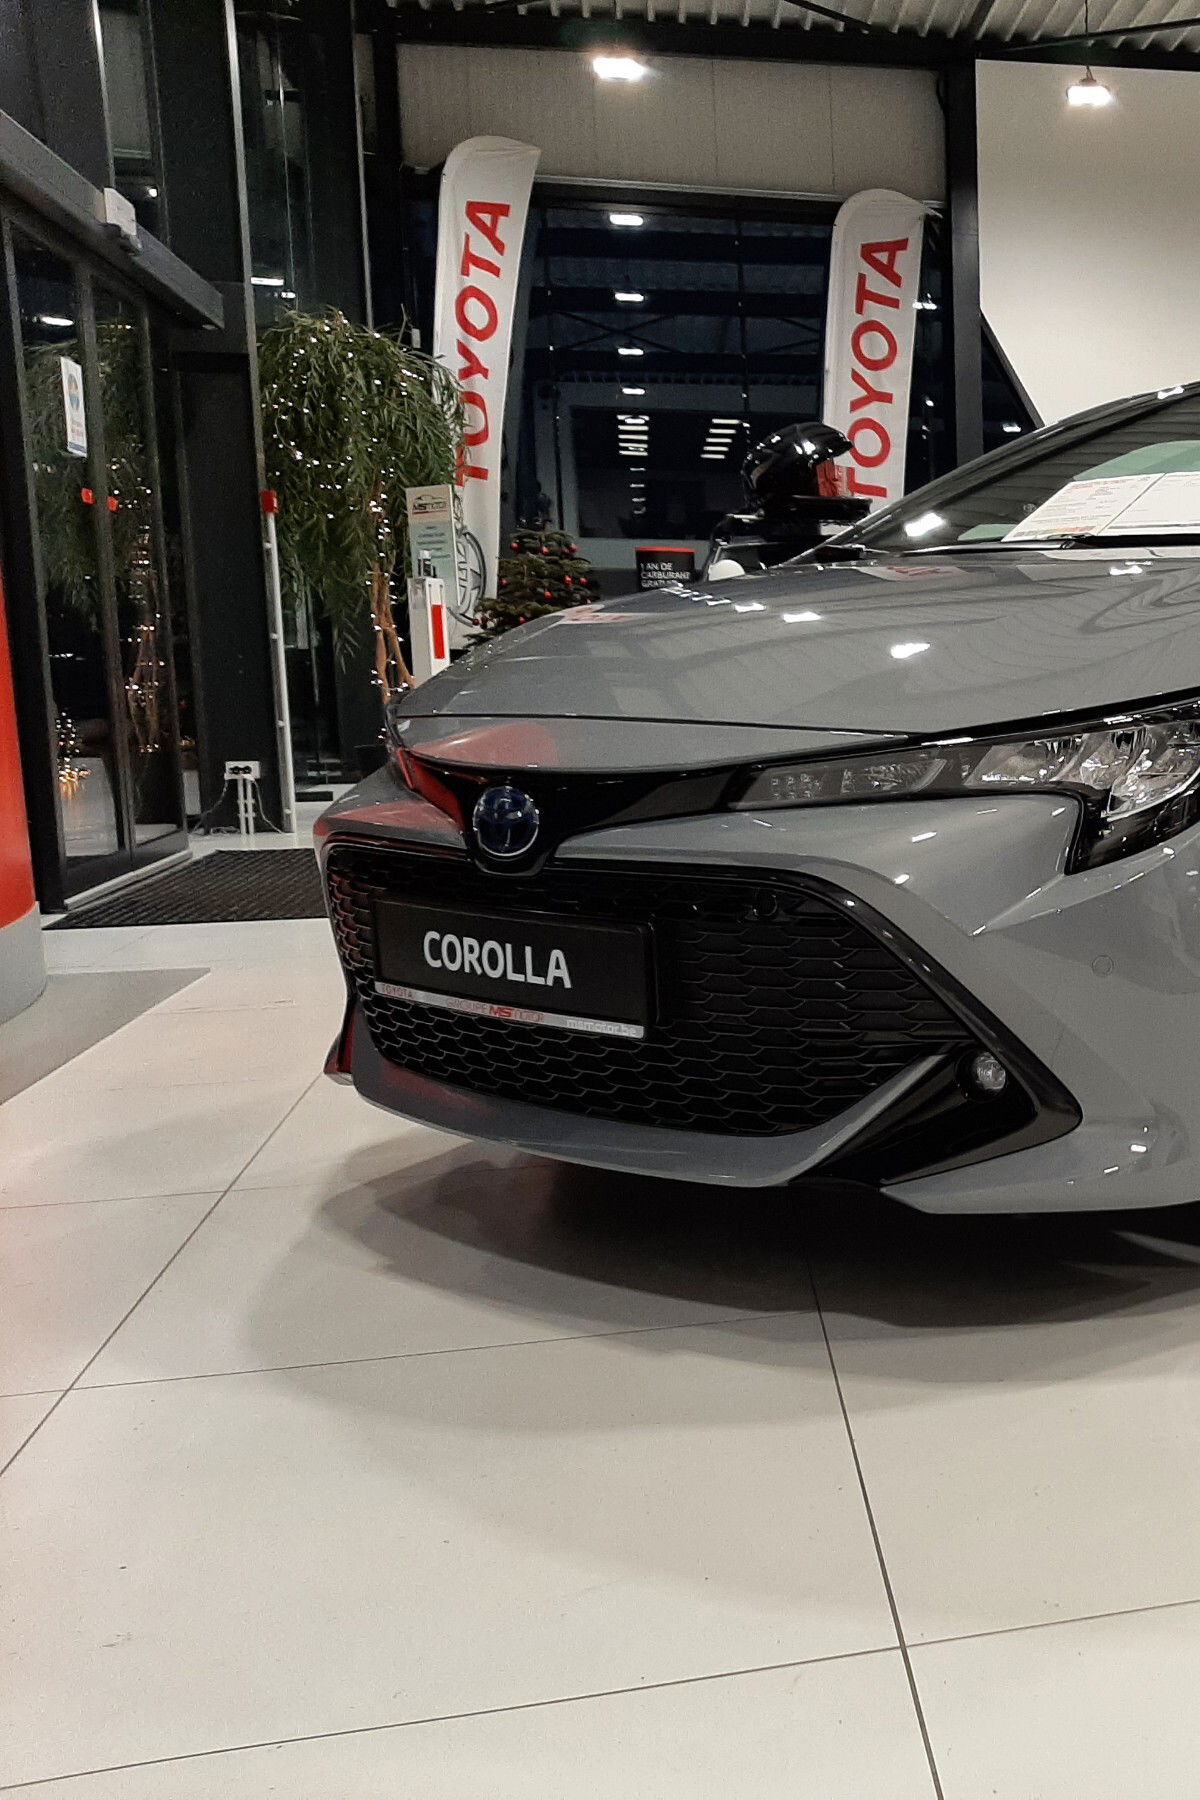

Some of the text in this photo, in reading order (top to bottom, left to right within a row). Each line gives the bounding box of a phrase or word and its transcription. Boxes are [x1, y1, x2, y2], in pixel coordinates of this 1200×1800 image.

[454, 201, 511, 487] TOYOTA
[847, 237, 909, 498] TOYOTA
[641, 571, 690, 580] CARBURANT
[660, 562, 673, 571] DE
[423, 930, 572, 989] COROLLA
[380, 983, 413, 999] TOYOTA
